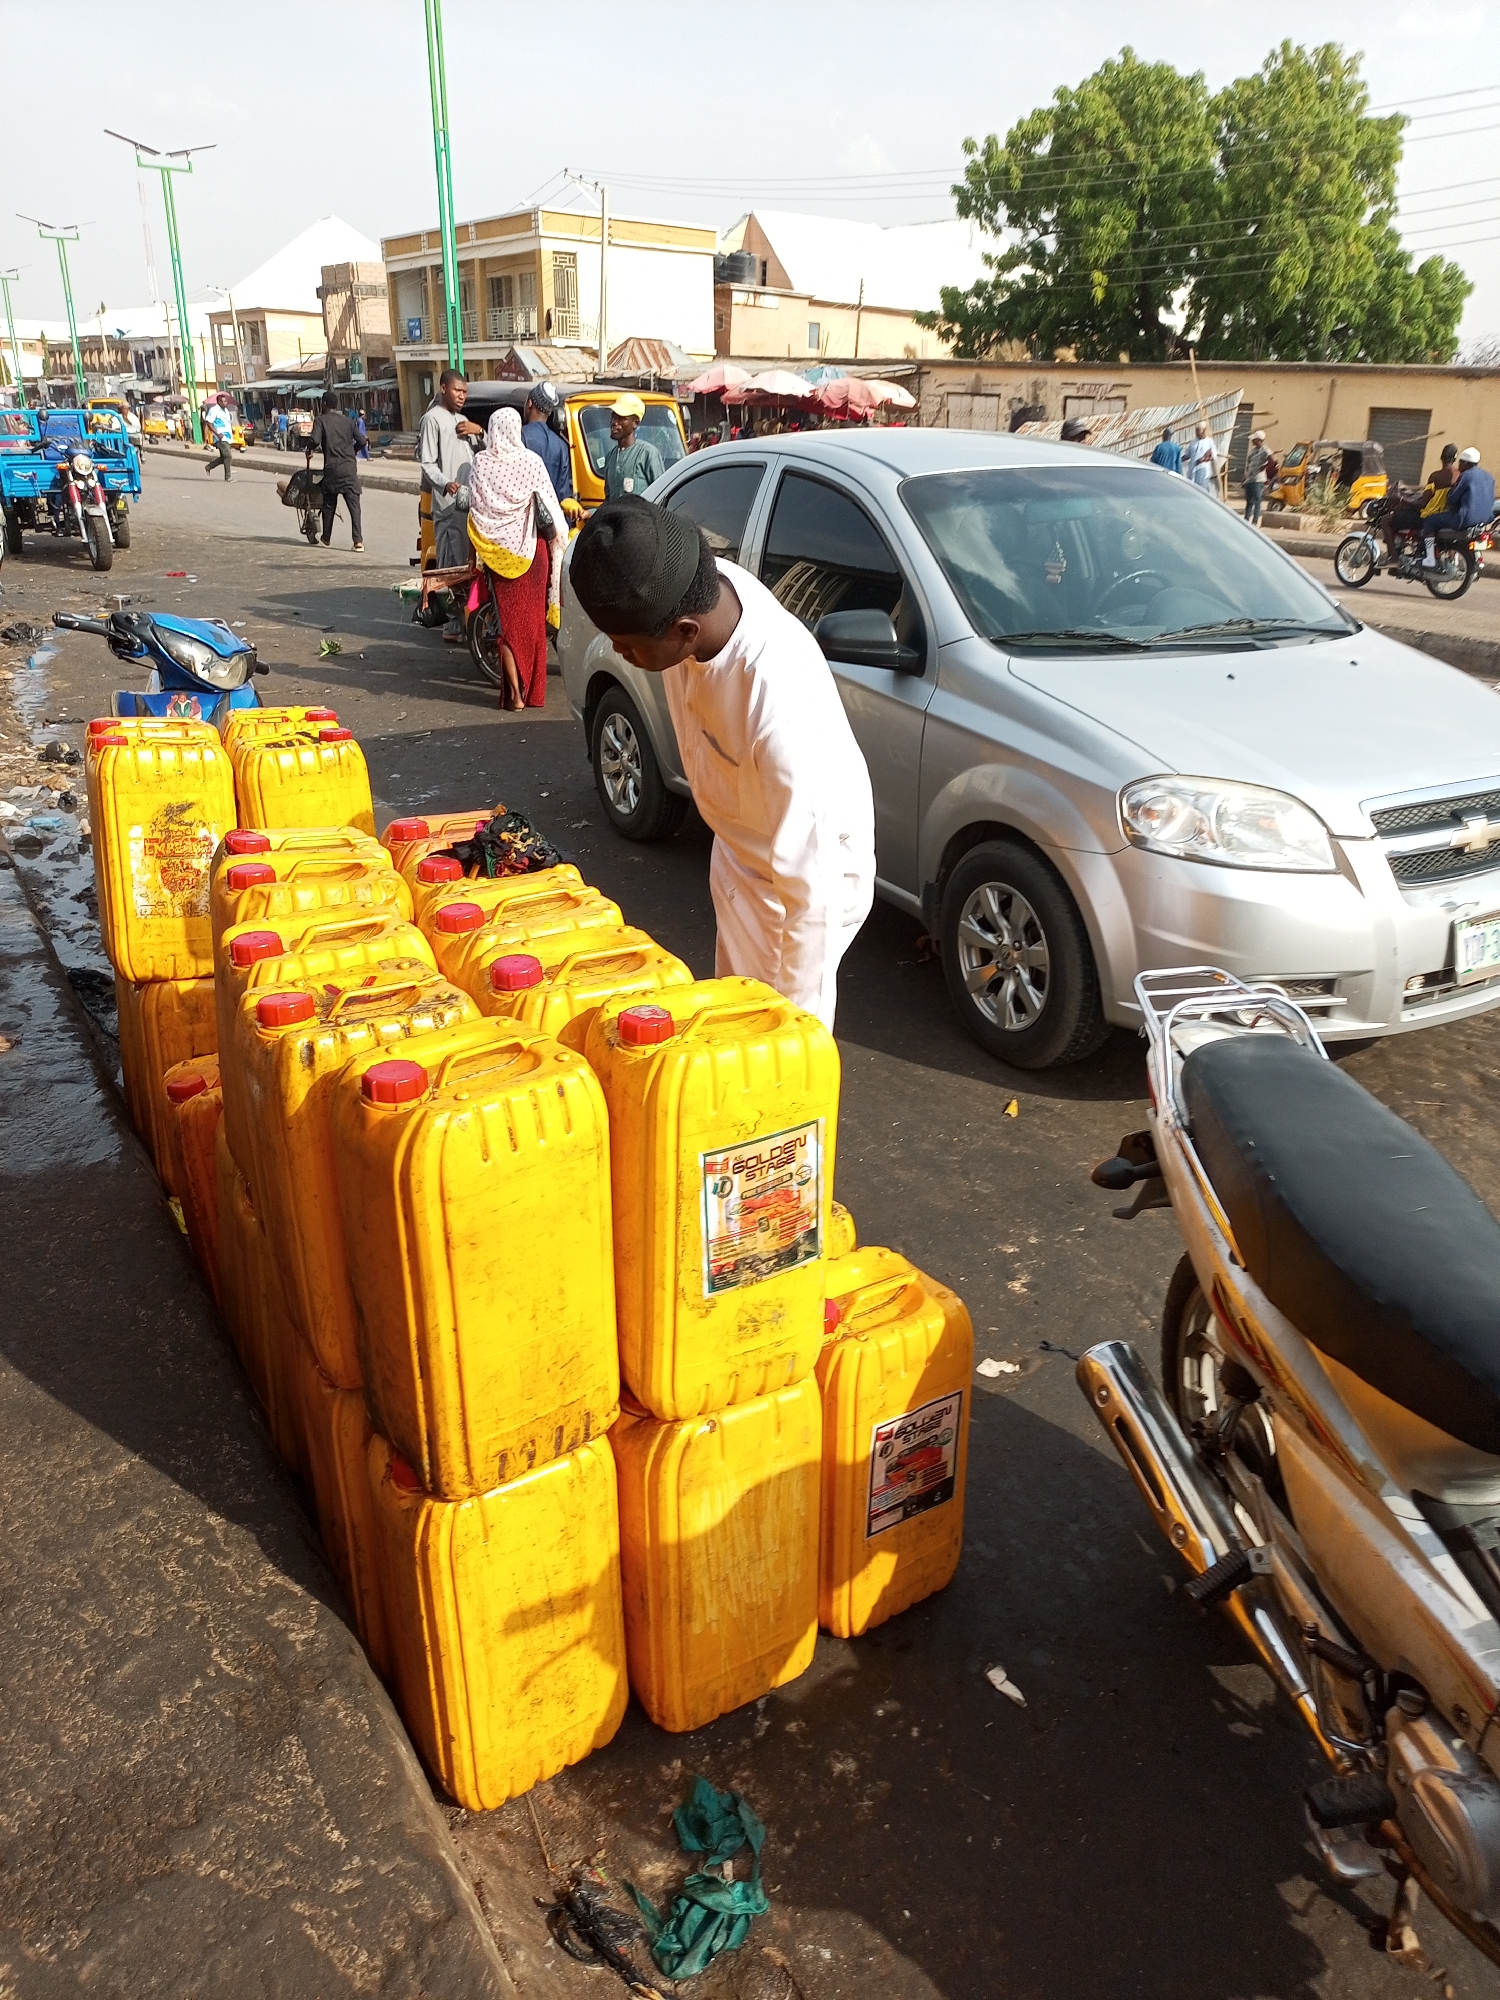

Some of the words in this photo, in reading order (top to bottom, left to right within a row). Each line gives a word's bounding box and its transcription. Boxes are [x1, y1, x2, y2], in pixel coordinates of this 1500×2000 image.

[732, 1134, 808, 1175] GOLDEN
[745, 1152, 797, 1182] STAGE
[894, 1405, 953, 1440] GOLDEN
[902, 1418, 942, 1445] STAGE
